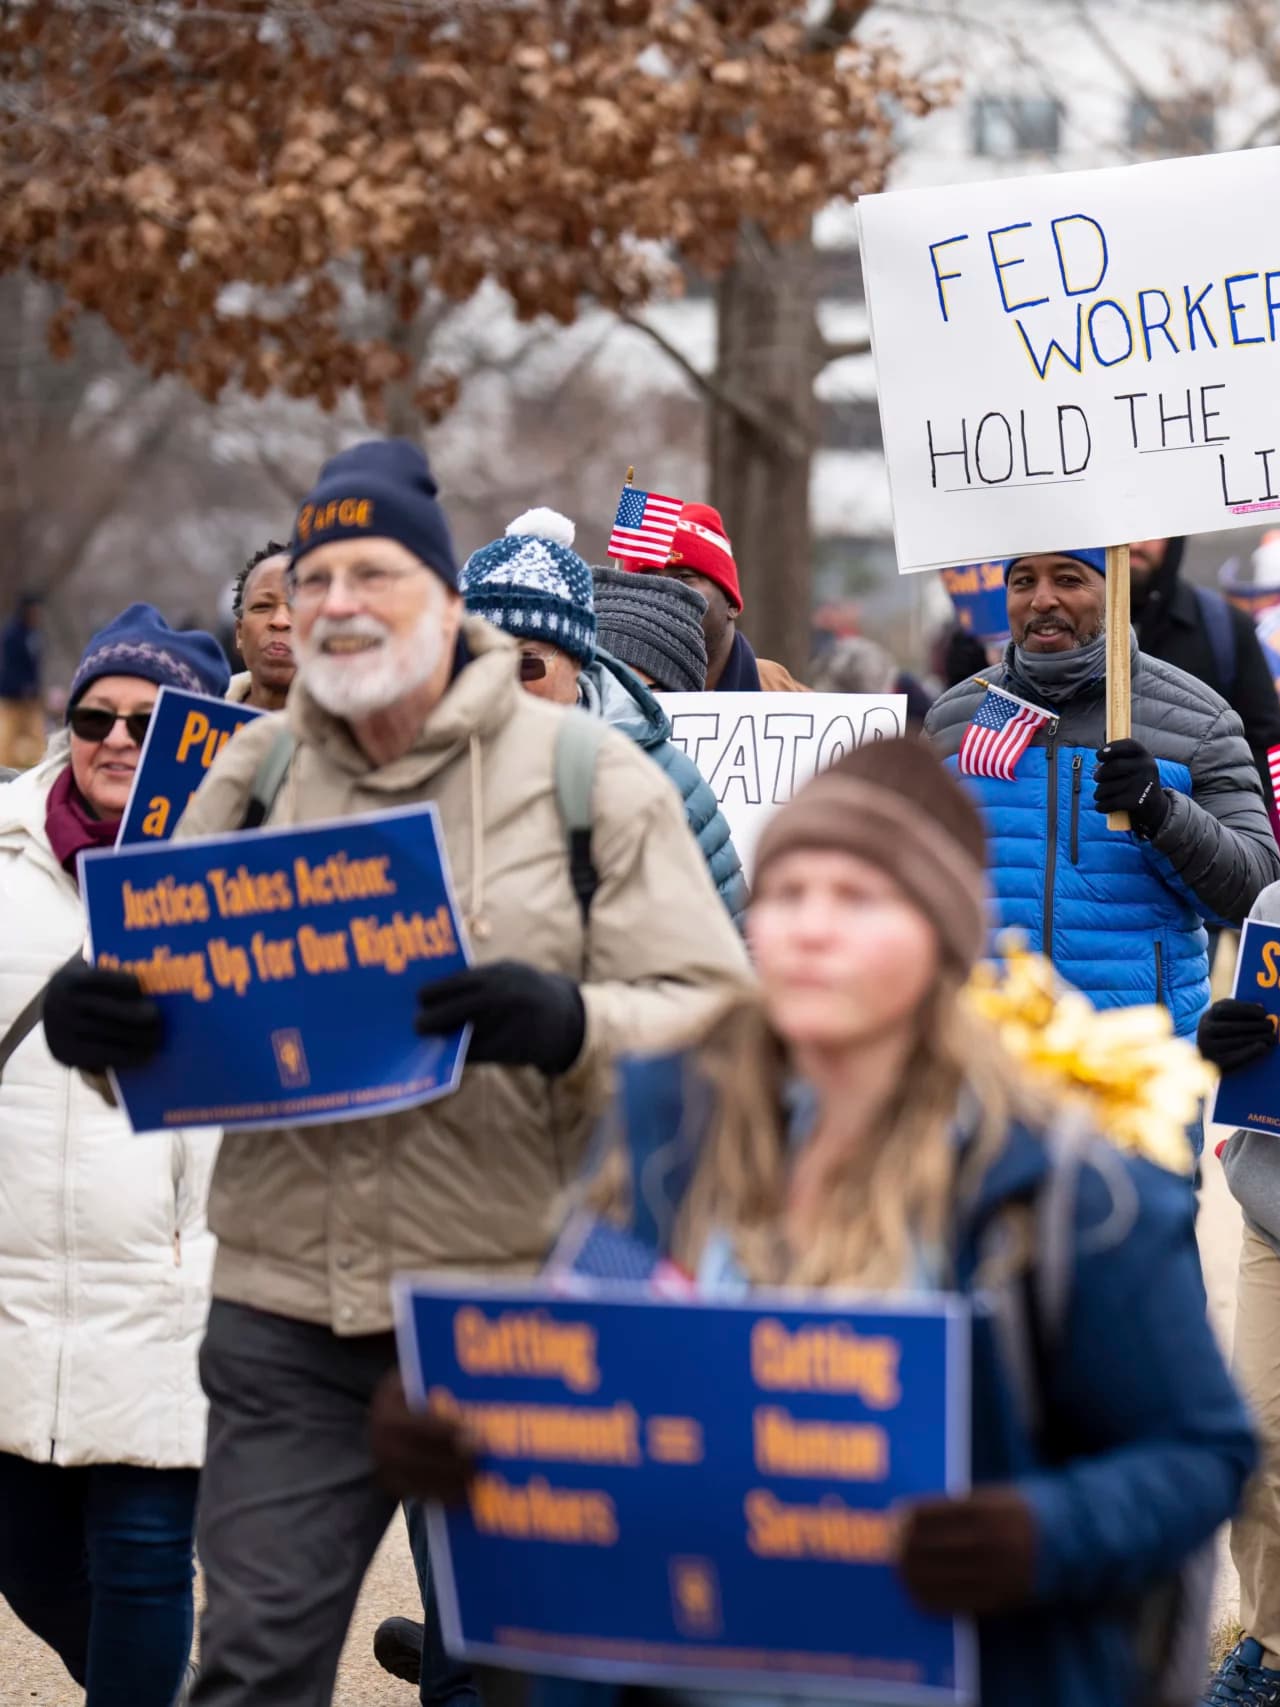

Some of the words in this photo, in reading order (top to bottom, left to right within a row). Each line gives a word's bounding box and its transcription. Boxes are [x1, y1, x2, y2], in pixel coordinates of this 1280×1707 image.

[929, 213, 1108, 322] FED
[926, 404, 1091, 488] HOLD
[1114, 384, 1230, 449] THE
[121, 874, 210, 931] Justice
[206, 864, 293, 919] Takes
[293, 850, 397, 906] Action:
[207, 938, 250, 997] Up
[251, 930, 296, 983] for
[296, 924, 349, 975] Our
[350, 904, 457, 975] Rights!
